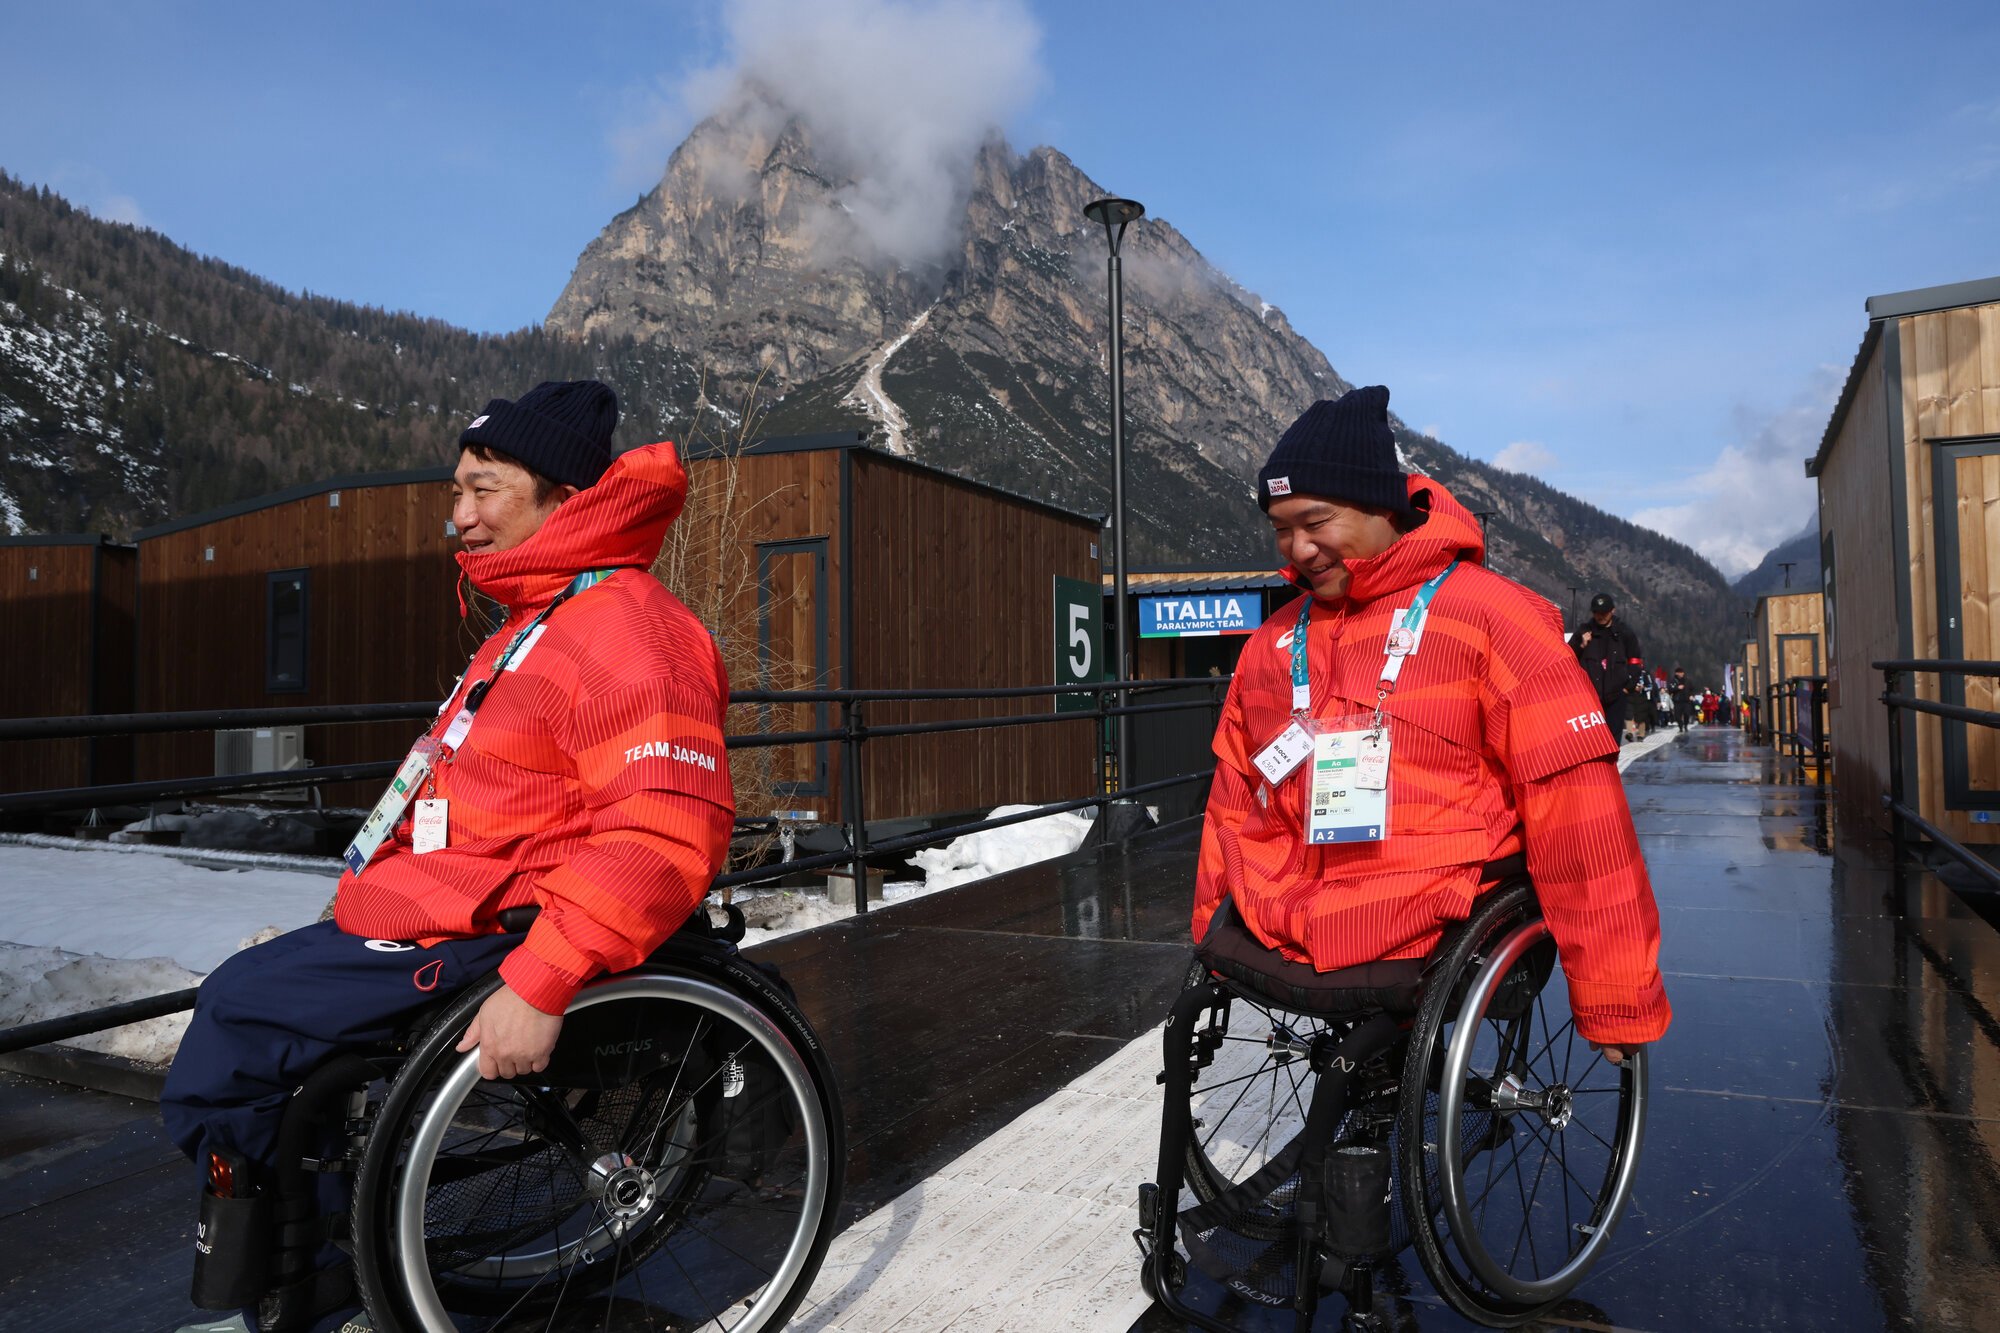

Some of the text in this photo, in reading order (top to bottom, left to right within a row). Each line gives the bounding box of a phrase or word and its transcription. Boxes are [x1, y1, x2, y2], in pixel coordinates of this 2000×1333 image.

[1270, 484, 1290, 494] JAPAN
[1155, 598, 1243, 621] ITALIA
[1156, 619, 1244, 631] PARALYMPIC TEAM
[1069, 603, 1092, 678] 5
[624, 741, 716, 772] TEAM JAPAN
[1316, 828, 1377, 840] A 2 R
[725, 964, 818, 1050] MARATHON PLUS
[728, 1052, 737, 1081] NORTH
[735, 1063, 744, 1081] THE
